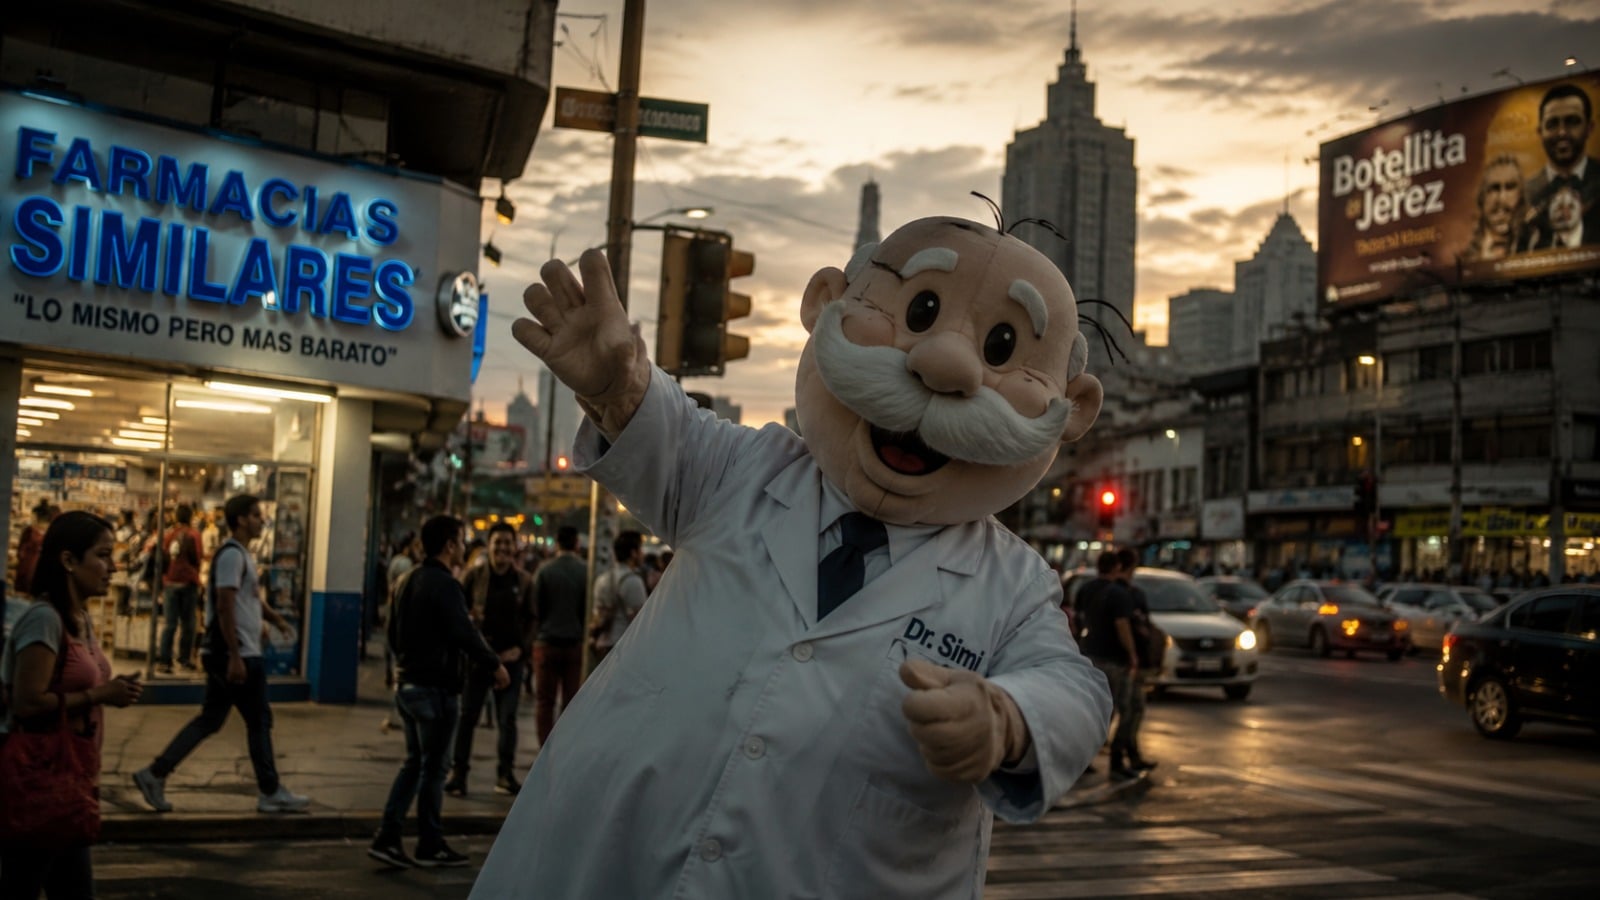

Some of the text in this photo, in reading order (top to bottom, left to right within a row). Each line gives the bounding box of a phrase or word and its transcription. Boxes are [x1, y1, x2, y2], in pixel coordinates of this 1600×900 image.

[16, 126, 400, 246] FARMACIAS
[1333, 129, 1467, 197] Botellita
[1355, 180, 1444, 231] Jerez
[10, 195, 415, 331] SIMILARES
[14, 293, 398, 366] "LO MISMO PERO MAS BARATO"
[904, 617, 986, 672] Dr. Simi
